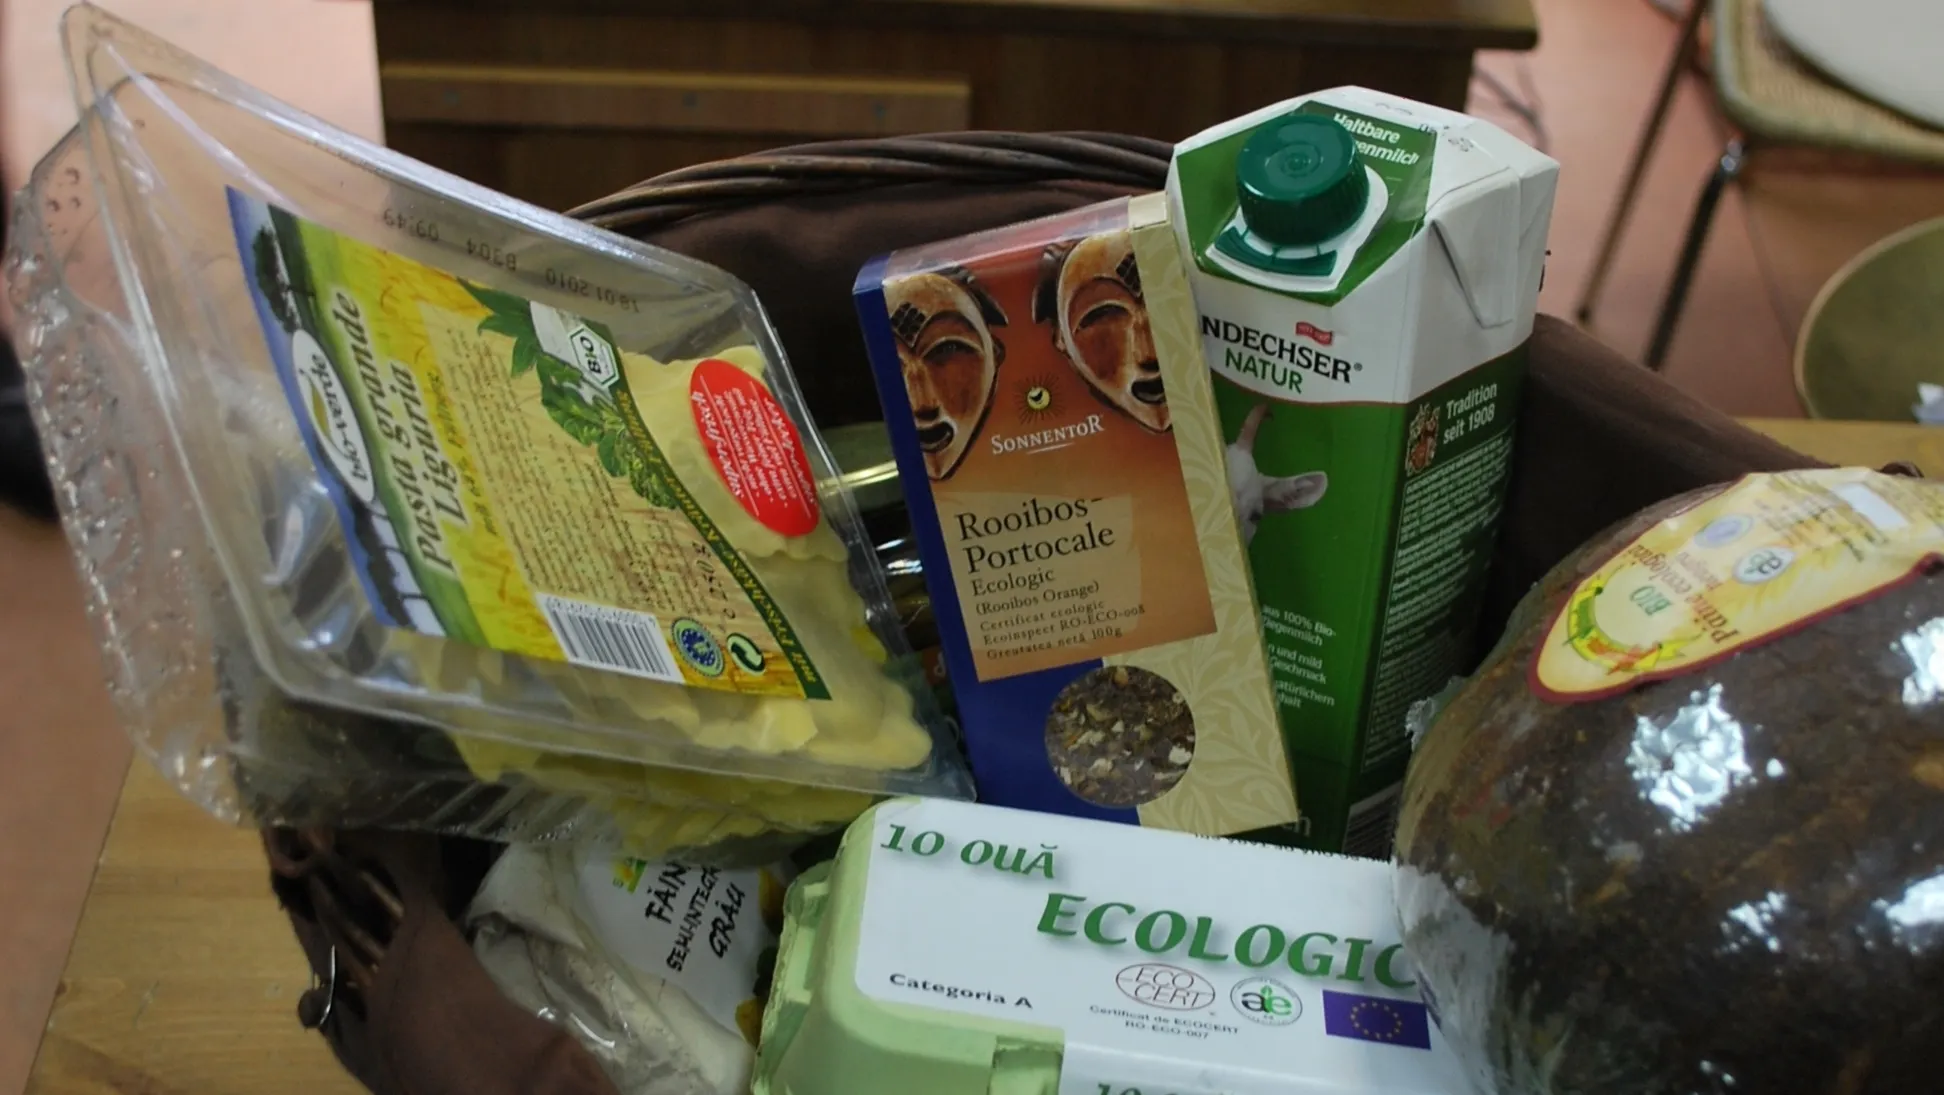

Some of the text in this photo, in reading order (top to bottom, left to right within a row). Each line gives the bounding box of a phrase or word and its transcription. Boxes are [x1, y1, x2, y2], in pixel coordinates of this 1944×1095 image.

[1333, 112, 1401, 143] Haltbare
[579, 336, 601, 373] BIO
[1226, 347, 1303, 394] NATUR
[311, 353, 368, 481] bio-verde
[1445, 382, 1497, 419] Tradition
[335, 292, 454, 571] Pasta grande
[1443, 403, 1496, 445] seit 1908
[390, 363, 466, 523] Liguria
[767, 470, 786, 499] extra
[954, 497, 1104, 542] Rooibos-
[962, 521, 1116, 574] Portocale
[971, 567, 1056, 597] Ecologic
[975, 580, 1100, 616] (Rooibos Orange)
[980, 600, 1105, 632] Certificat ecologic
[1630, 585, 1672, 616] BIO
[983, 624, 1056, 646] Ecoinspect
[1284, 610, 1313, 630] 100%
[1314, 621, 1336, 637] Bio-
[986, 641, 1052, 660] Greutatea
[1058, 630, 1087, 648] netă
[1276, 646, 1297, 661] und
[1298, 653, 1323, 669] mild
[880, 824, 945, 857] 10
[644, 861, 691, 924] FĂIN
[667, 864, 721, 972] SEMI-INTEGR
[889, 972, 1033, 1009] Categoria A
[1134, 981, 1200, 1008] CERT
[1135, 966, 1194, 989] ECO
[1089, 1004, 1149, 1021] Certificat
[1154, 1013, 1170, 1025] de
[1174, 1017, 1239, 1035] ECOCERT
